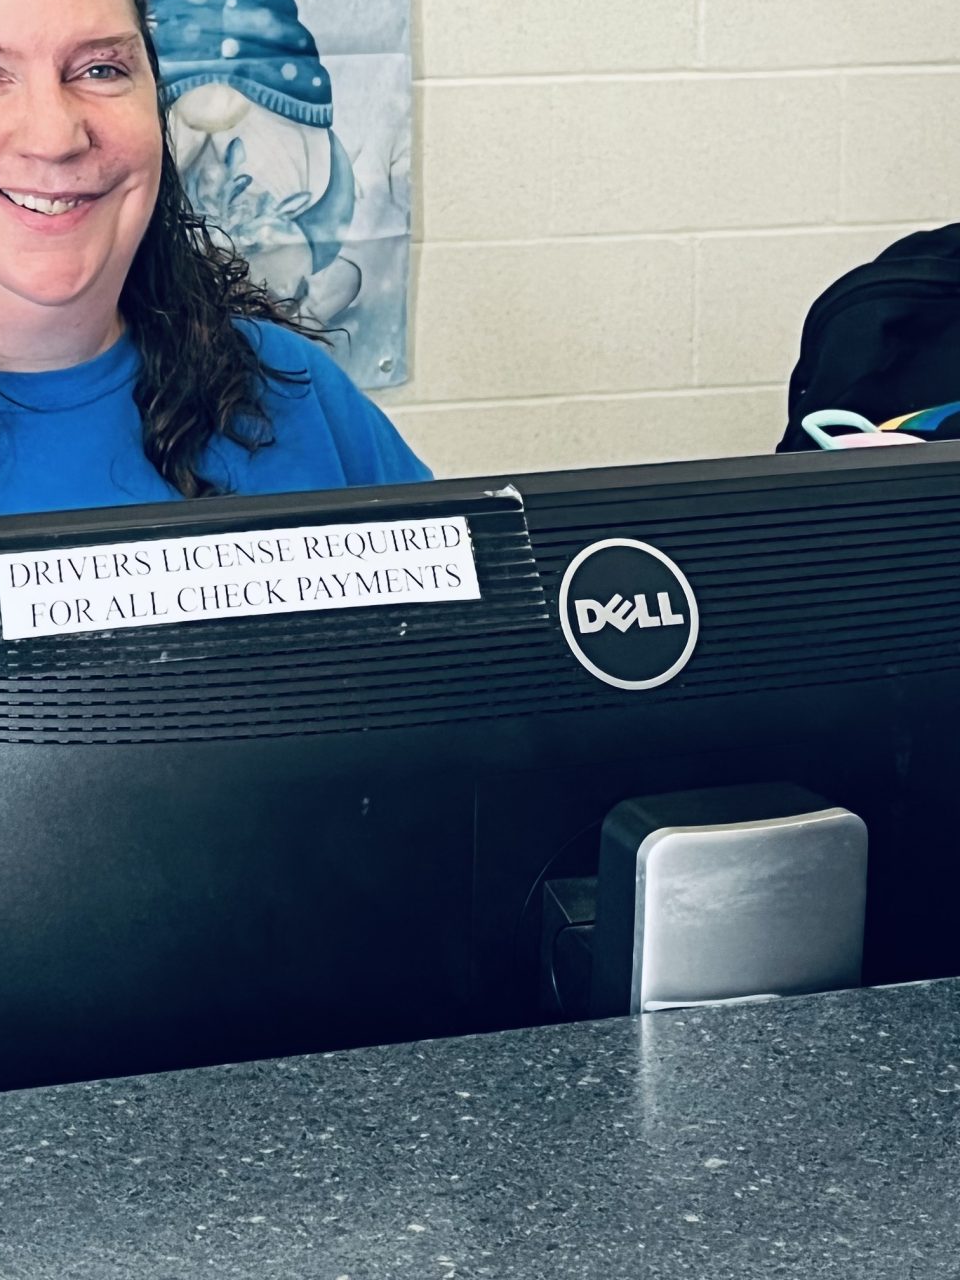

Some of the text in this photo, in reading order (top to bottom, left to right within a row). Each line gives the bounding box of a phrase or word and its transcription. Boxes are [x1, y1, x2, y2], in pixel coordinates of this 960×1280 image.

[8, 523, 462, 590] DRIVERS LICENSE REQUIRED
[30, 562, 464, 629] FOR ALL CHECK PAYMENTS
[574, 592, 685, 634] DELL
